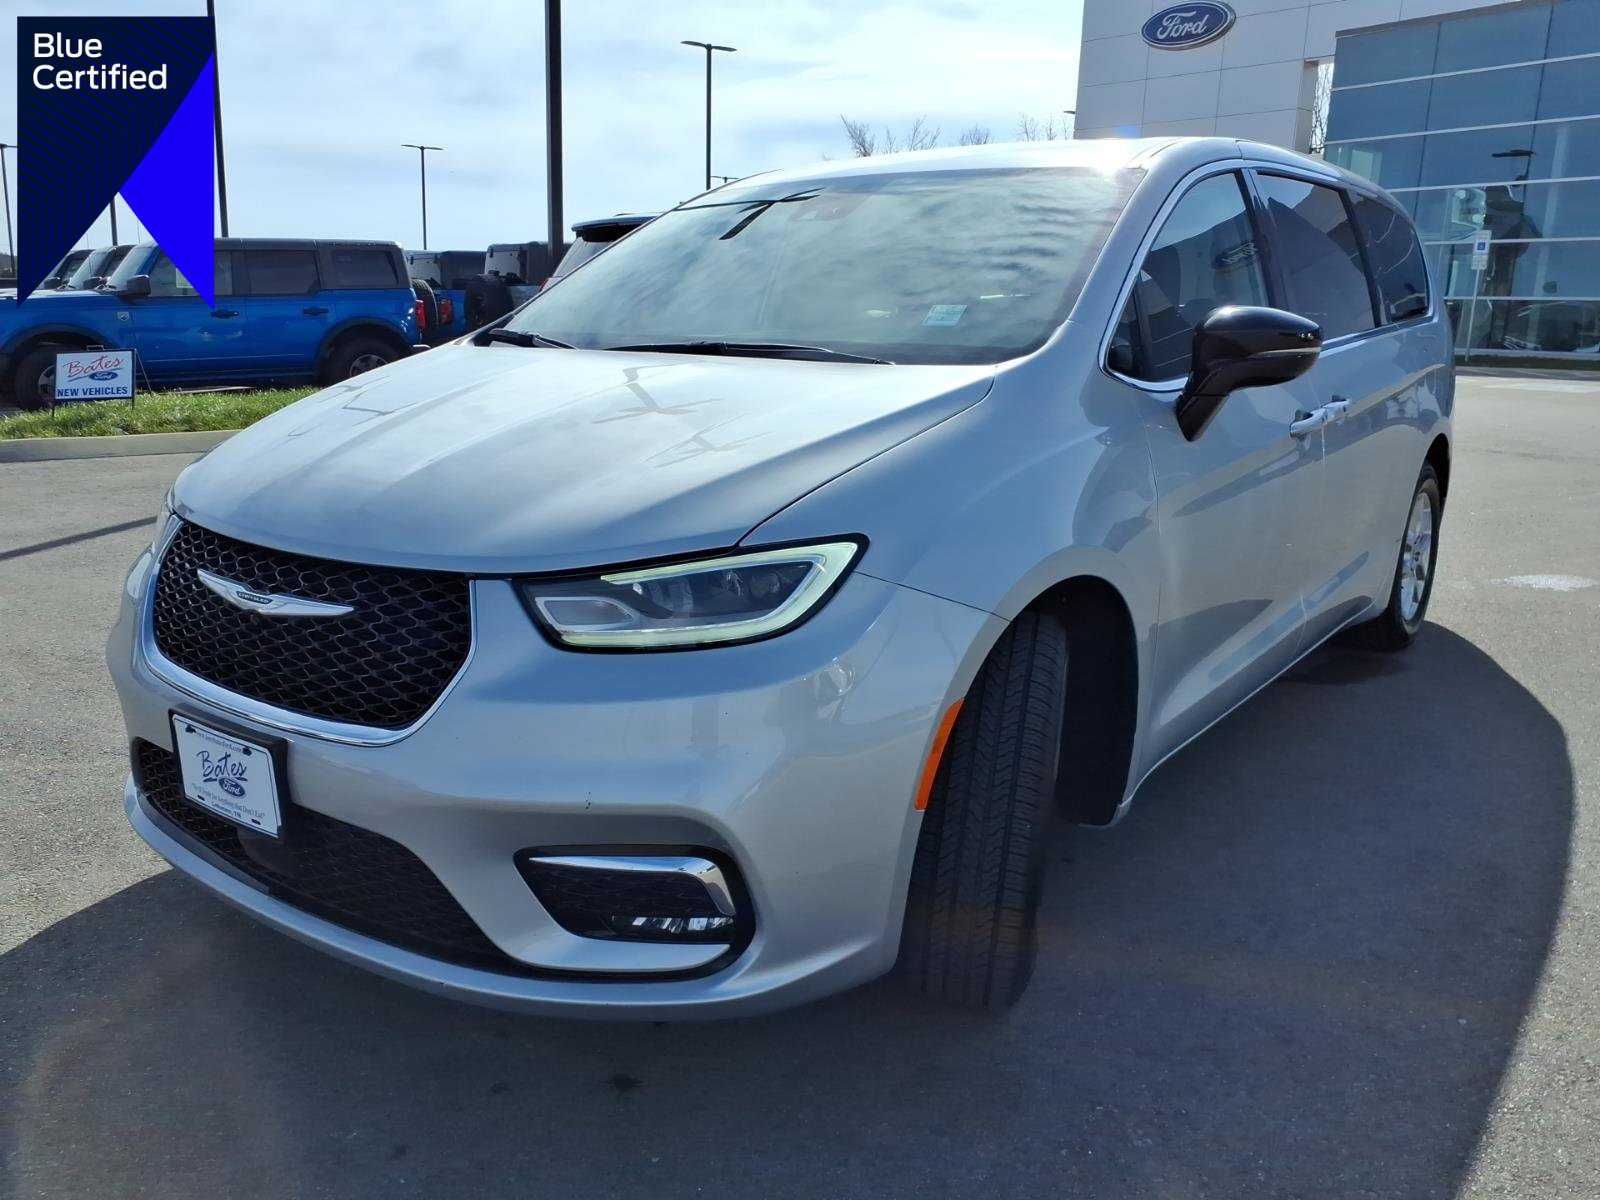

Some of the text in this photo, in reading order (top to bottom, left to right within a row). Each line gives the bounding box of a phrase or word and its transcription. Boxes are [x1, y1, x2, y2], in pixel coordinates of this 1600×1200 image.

[1157, 11, 1209, 39] Ford
[63, 355, 124, 377] Bates
[57, 386, 128, 397] NEW VEHICLES
[196, 750, 247, 778] Bates
